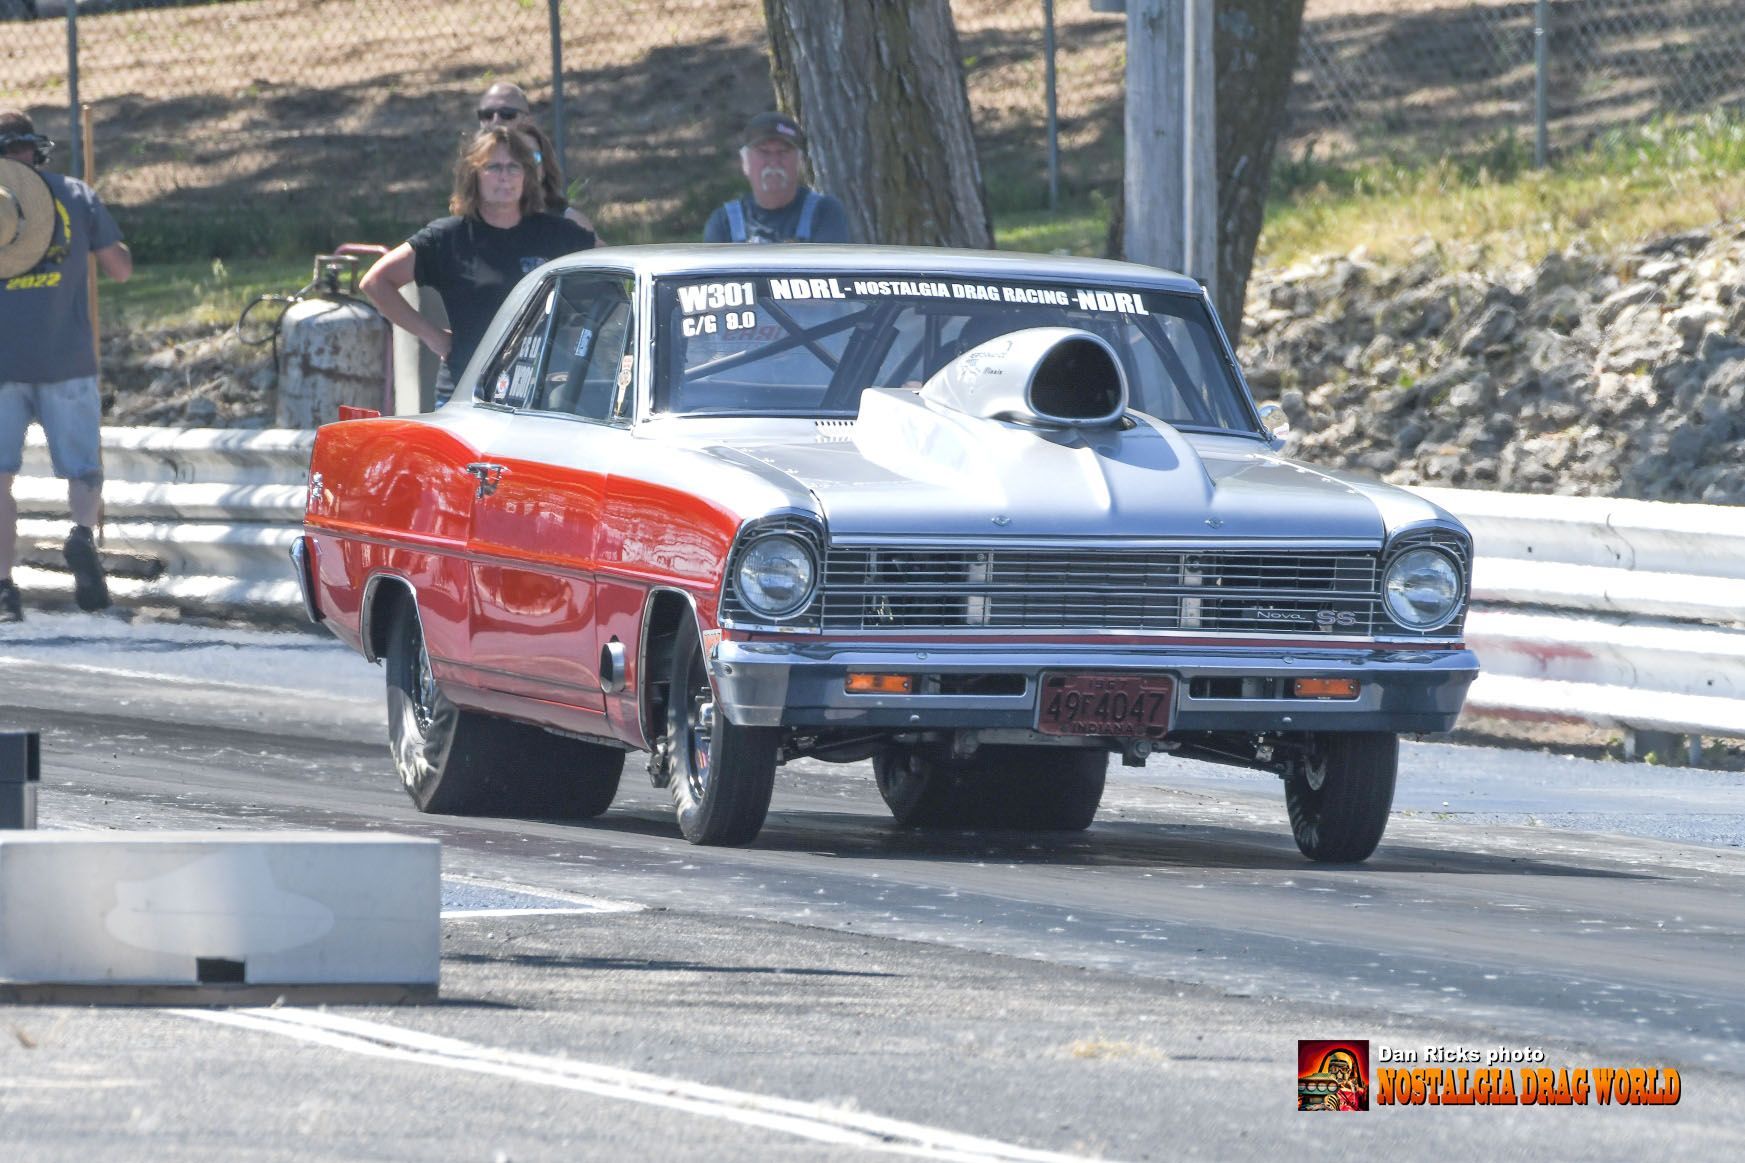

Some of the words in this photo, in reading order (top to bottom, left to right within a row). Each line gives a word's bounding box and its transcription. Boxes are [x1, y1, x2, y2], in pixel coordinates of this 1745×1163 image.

[678, 282, 754, 313] W301
[854, 281, 951, 297] NOSTALGIA
[951, 284, 1001, 301] DRAG
[1002, 287, 1069, 305] RACING
[683, 314, 717, 337] C/G
[1257, 611, 1306, 620] Nova
[1316, 609, 1356, 626] SS
[1072, 721, 1134, 734] INDIANA
